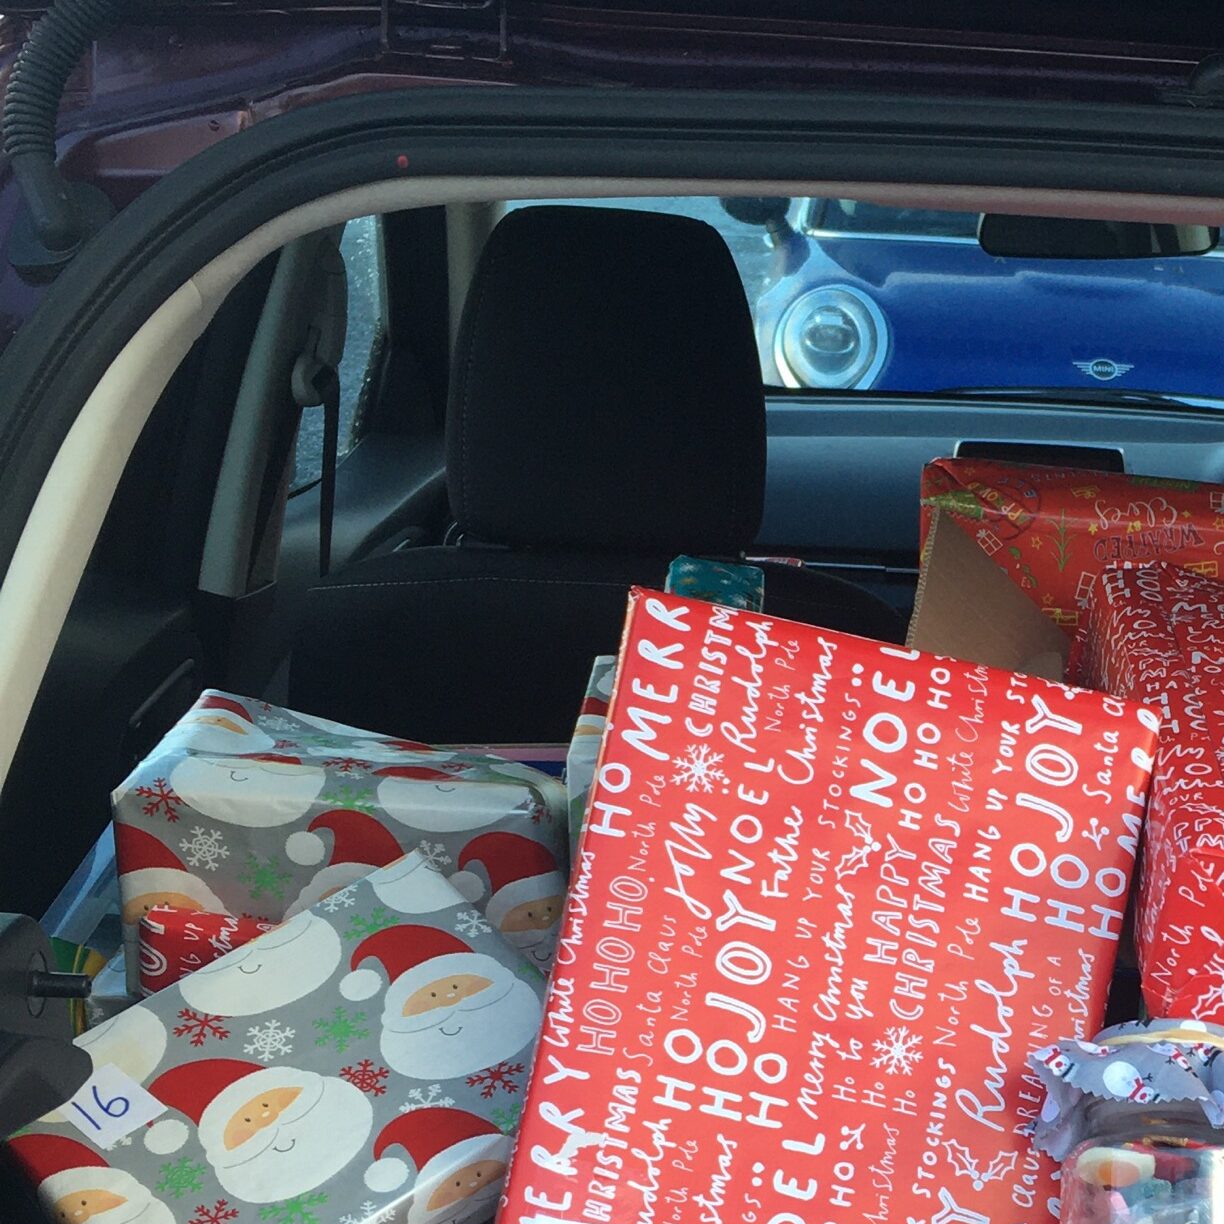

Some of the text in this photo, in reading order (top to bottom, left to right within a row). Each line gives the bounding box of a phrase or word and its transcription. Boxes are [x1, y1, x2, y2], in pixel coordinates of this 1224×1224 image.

[720, 619, 779, 753] Rudolph
[764, 685, 792, 733] North
[760, 636, 839, 899] Father Christmas
[946, 751, 976, 814] White
[992, 721, 1023, 776] YOUR
[1015, 693, 1084, 844] JOY
[1082, 729, 1121, 806] Santa
[984, 788, 1009, 812] UP
[628, 821, 658, 873] North
[771, 692, 862, 1034] HANG UP YOUR STOCKINGS
[963, 825, 1003, 904] HANG
[1000, 843, 1048, 923] HO
[557, 850, 596, 967] Christmas
[864, 833, 917, 966] HAPPY
[889, 813, 962, 1021] CHRISTMAS
[1045, 853, 1090, 934] HO
[1087, 867, 1128, 941] HO
[622, 914, 678, 1069] Santa Claus
[669, 971, 699, 1023] North
[704, 888, 778, 1045] JOY
[797, 882, 857, 1121] Merry Christmas
[932, 979, 970, 1048] North
[955, 938, 1036, 1133] Rudolph
[71, 1084, 131, 1131] 16
[652, 1027, 704, 1113] HO
[699, 1039, 749, 1123] HO
[745, 1052, 791, 1130] HO
[912, 1057, 957, 1200] STOCKINGS
[829, 1161, 855, 1207] HO
[1011, 1146, 1041, 1209] Claus
